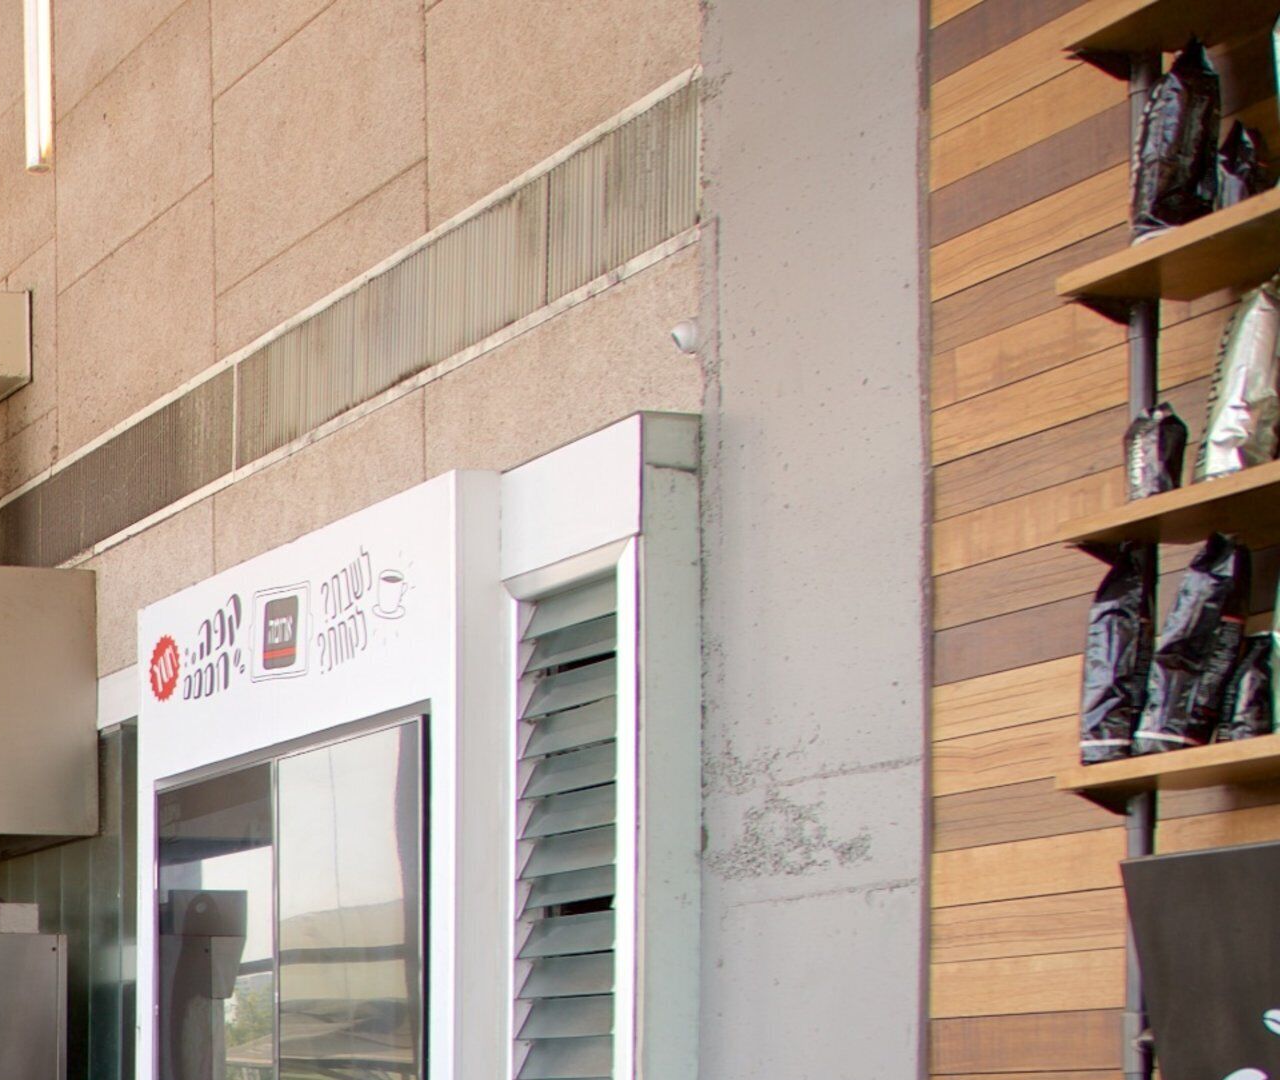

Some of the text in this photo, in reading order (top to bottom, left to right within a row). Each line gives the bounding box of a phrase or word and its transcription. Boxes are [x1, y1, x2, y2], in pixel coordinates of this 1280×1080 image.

[321, 545, 373, 623] לשבת?
[198, 593, 242, 660] קפה
[317, 606, 367, 675] לקחת?
